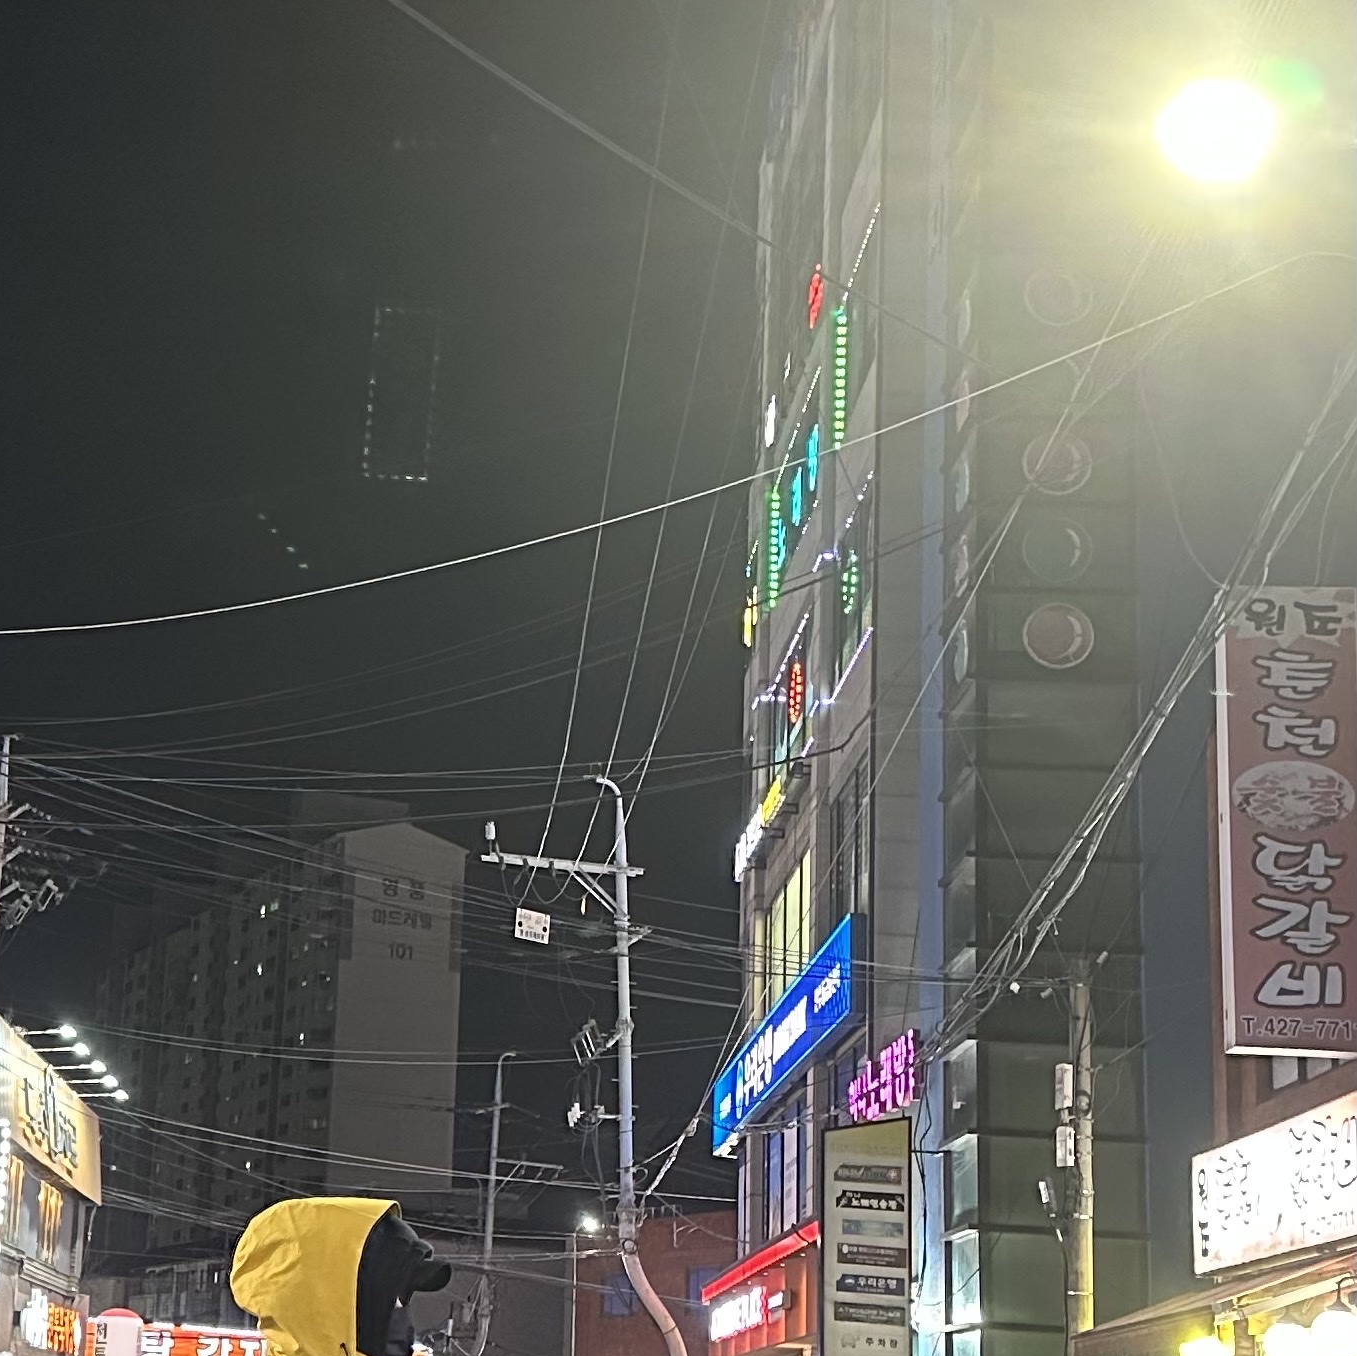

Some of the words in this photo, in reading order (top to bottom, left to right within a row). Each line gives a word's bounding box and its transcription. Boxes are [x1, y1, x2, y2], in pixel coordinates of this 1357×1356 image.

[1253, 833, 1352, 1008] 닭갈비
[387, 943, 413, 961] 101
[743, 1024, 773, 1107] 우리은행
[857, 1276, 897, 1290] 우리은행
